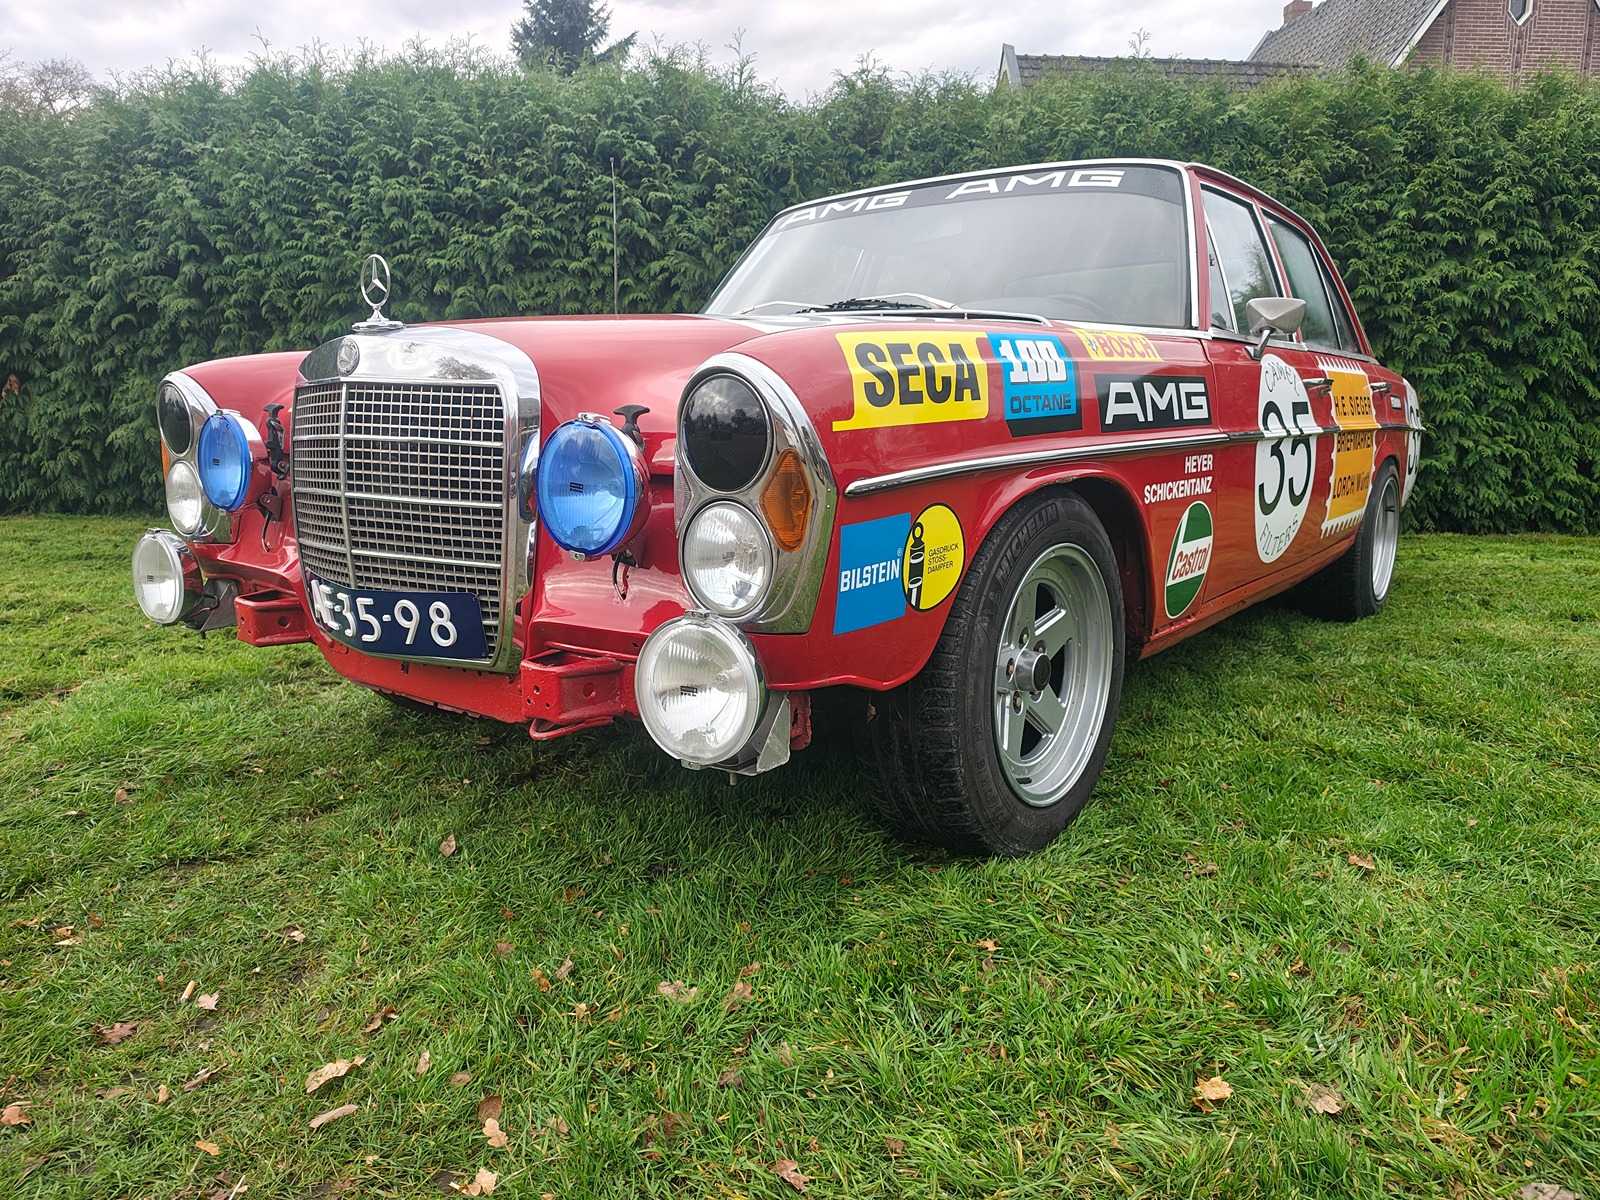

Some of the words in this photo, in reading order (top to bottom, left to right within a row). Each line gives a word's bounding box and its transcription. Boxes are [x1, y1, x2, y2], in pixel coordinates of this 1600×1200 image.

[779, 191, 912, 229] AMG
[945, 170, 1125, 199] AMG
[1000, 339, 1067, 384] 100
[1095, 335, 1160, 358] BOSCH
[856, 342, 981, 407] SECA
[1264, 361, 1300, 396] CAMEL
[1010, 392, 1072, 414] OCTANE
[1105, 382, 1209, 425] AMG
[1349, 395, 1372, 416] SIEGER
[1184, 454, 1213, 473] HEYER
[1258, 400, 1312, 516] 35
[1144, 476, 1212, 504] SCHICKENTANZ
[928, 543, 959, 557] GASDRUCK
[994, 503, 1057, 592] MICHELIN
[1259, 513, 1298, 556] FILTERS
[840, 558, 900, 592] BILSTEIN
[1172, 544, 1211, 581] Castrol
